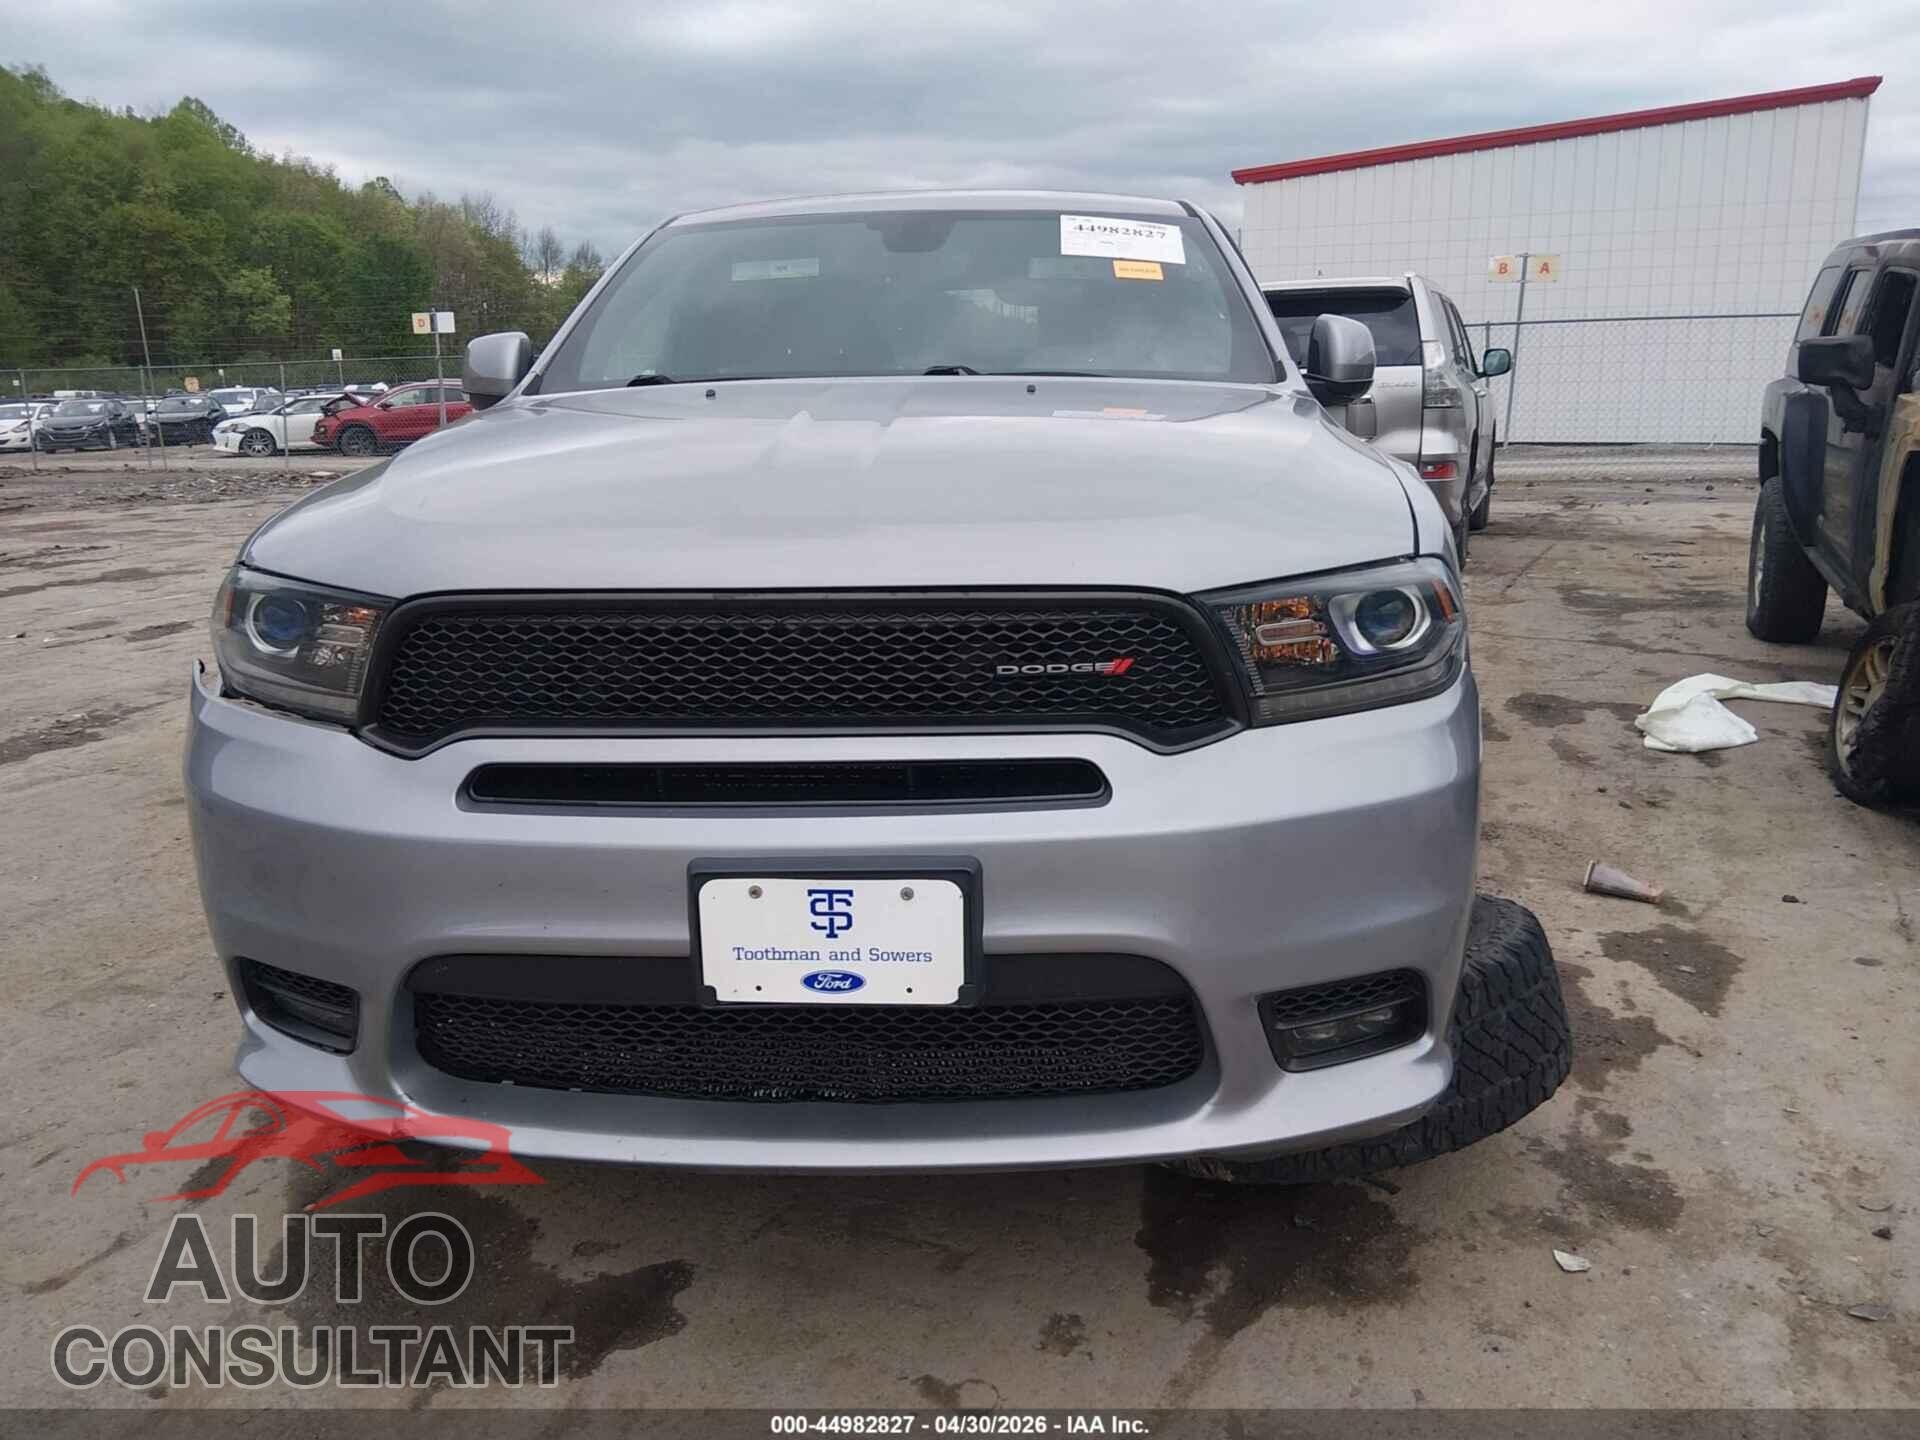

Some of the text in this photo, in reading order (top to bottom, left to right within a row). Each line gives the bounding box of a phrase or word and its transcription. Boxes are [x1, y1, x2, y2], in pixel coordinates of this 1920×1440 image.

[1073, 223, 1167, 239] 44982827
[1497, 262, 1508, 274] B
[1539, 262, 1550, 274] A
[996, 662, 1115, 675] DODGE
[732, 946, 933, 964] Toothman and Sowers
[814, 973, 853, 989] Ford
